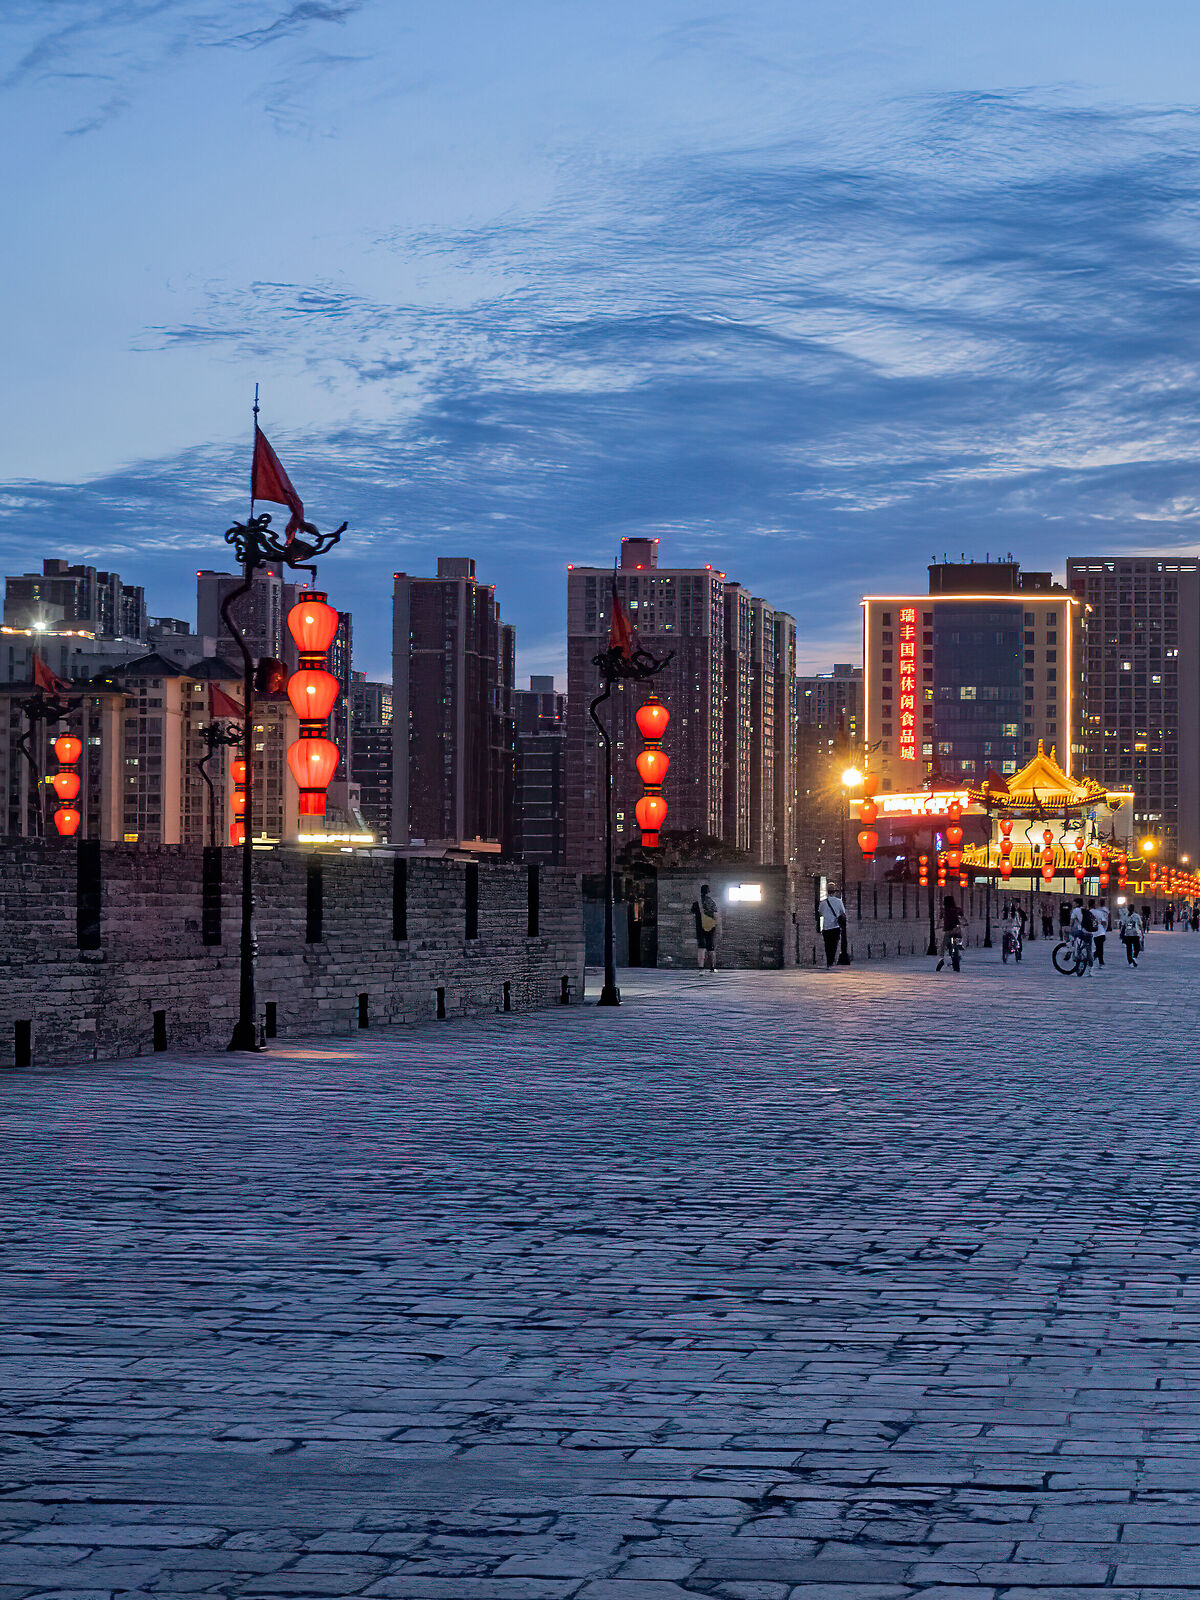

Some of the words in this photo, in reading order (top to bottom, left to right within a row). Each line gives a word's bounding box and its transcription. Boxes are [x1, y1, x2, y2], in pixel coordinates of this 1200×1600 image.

[899, 608, 916, 761] 瑞丰国际休闲食品城
